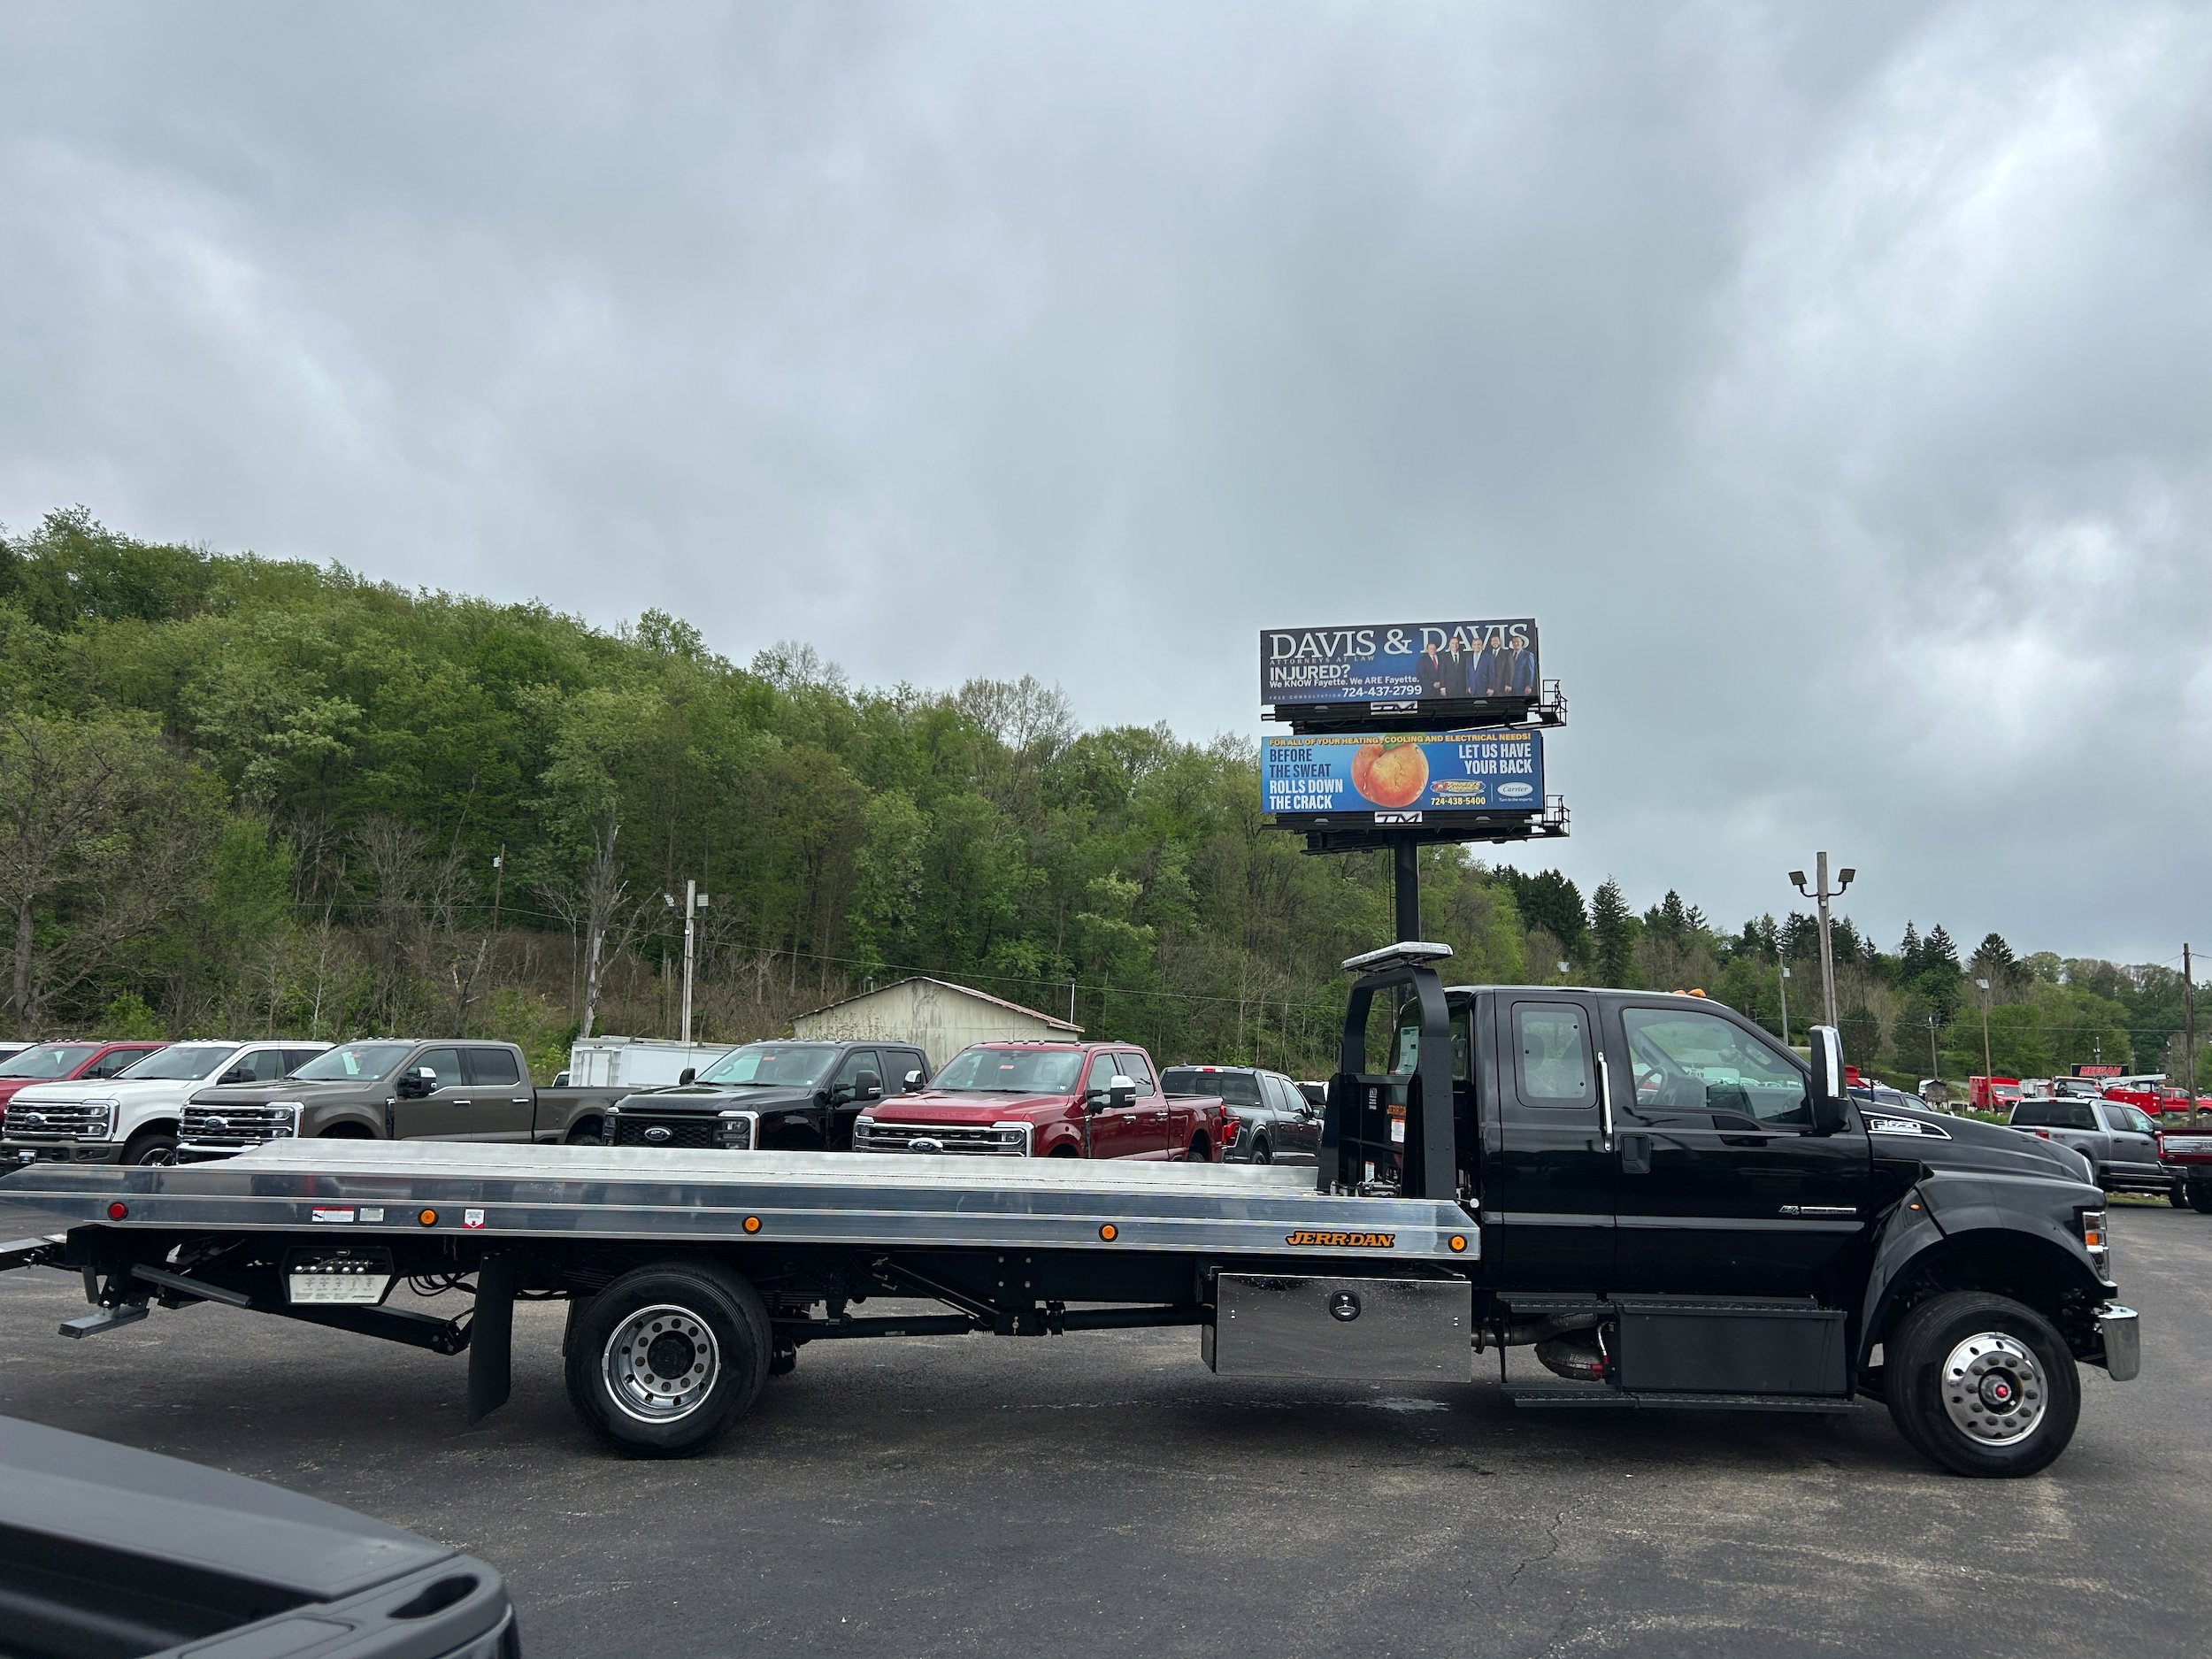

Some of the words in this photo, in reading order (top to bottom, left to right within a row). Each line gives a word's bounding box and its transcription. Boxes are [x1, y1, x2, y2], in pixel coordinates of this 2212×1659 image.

[1269, 630, 1377, 660] DAVIS
[1384, 629, 1413, 655] &
[1419, 624, 1531, 654] DAVIS
[1269, 657, 1331, 665] ATTORNEYS
[1270, 664, 1351, 681] INJURED?
[1284, 679, 1312, 687] KNOW
[1314, 677, 1348, 687] Fayette.
[1349, 677, 1363, 686] We
[1364, 676, 1383, 685] ARE
[1385, 675, 1420, 685] Fayette.
[1341, 685, 1423, 698] 724-437-2799
[1445, 733, 1498, 742] ELECTRICAL
[1270, 749, 1312, 762] BEFORE
[1459, 744, 1479, 759] LET
[1482, 744, 1498, 758] US
[1500, 743, 1532, 757] HAVE
[1270, 764, 1291, 778] THE
[1293, 764, 1332, 777] SWEAT
[1464, 760, 1498, 775] YOUR
[1500, 759, 1533, 774] BACK
[1270, 780, 1306, 794] ROLLS
[1308, 779, 1343, 793] DOWN
[1270, 795, 1291, 810] THE
[1293, 795, 1333, 809] CRACK
[1286, 1231, 1395, 1248] JERR-DAN
